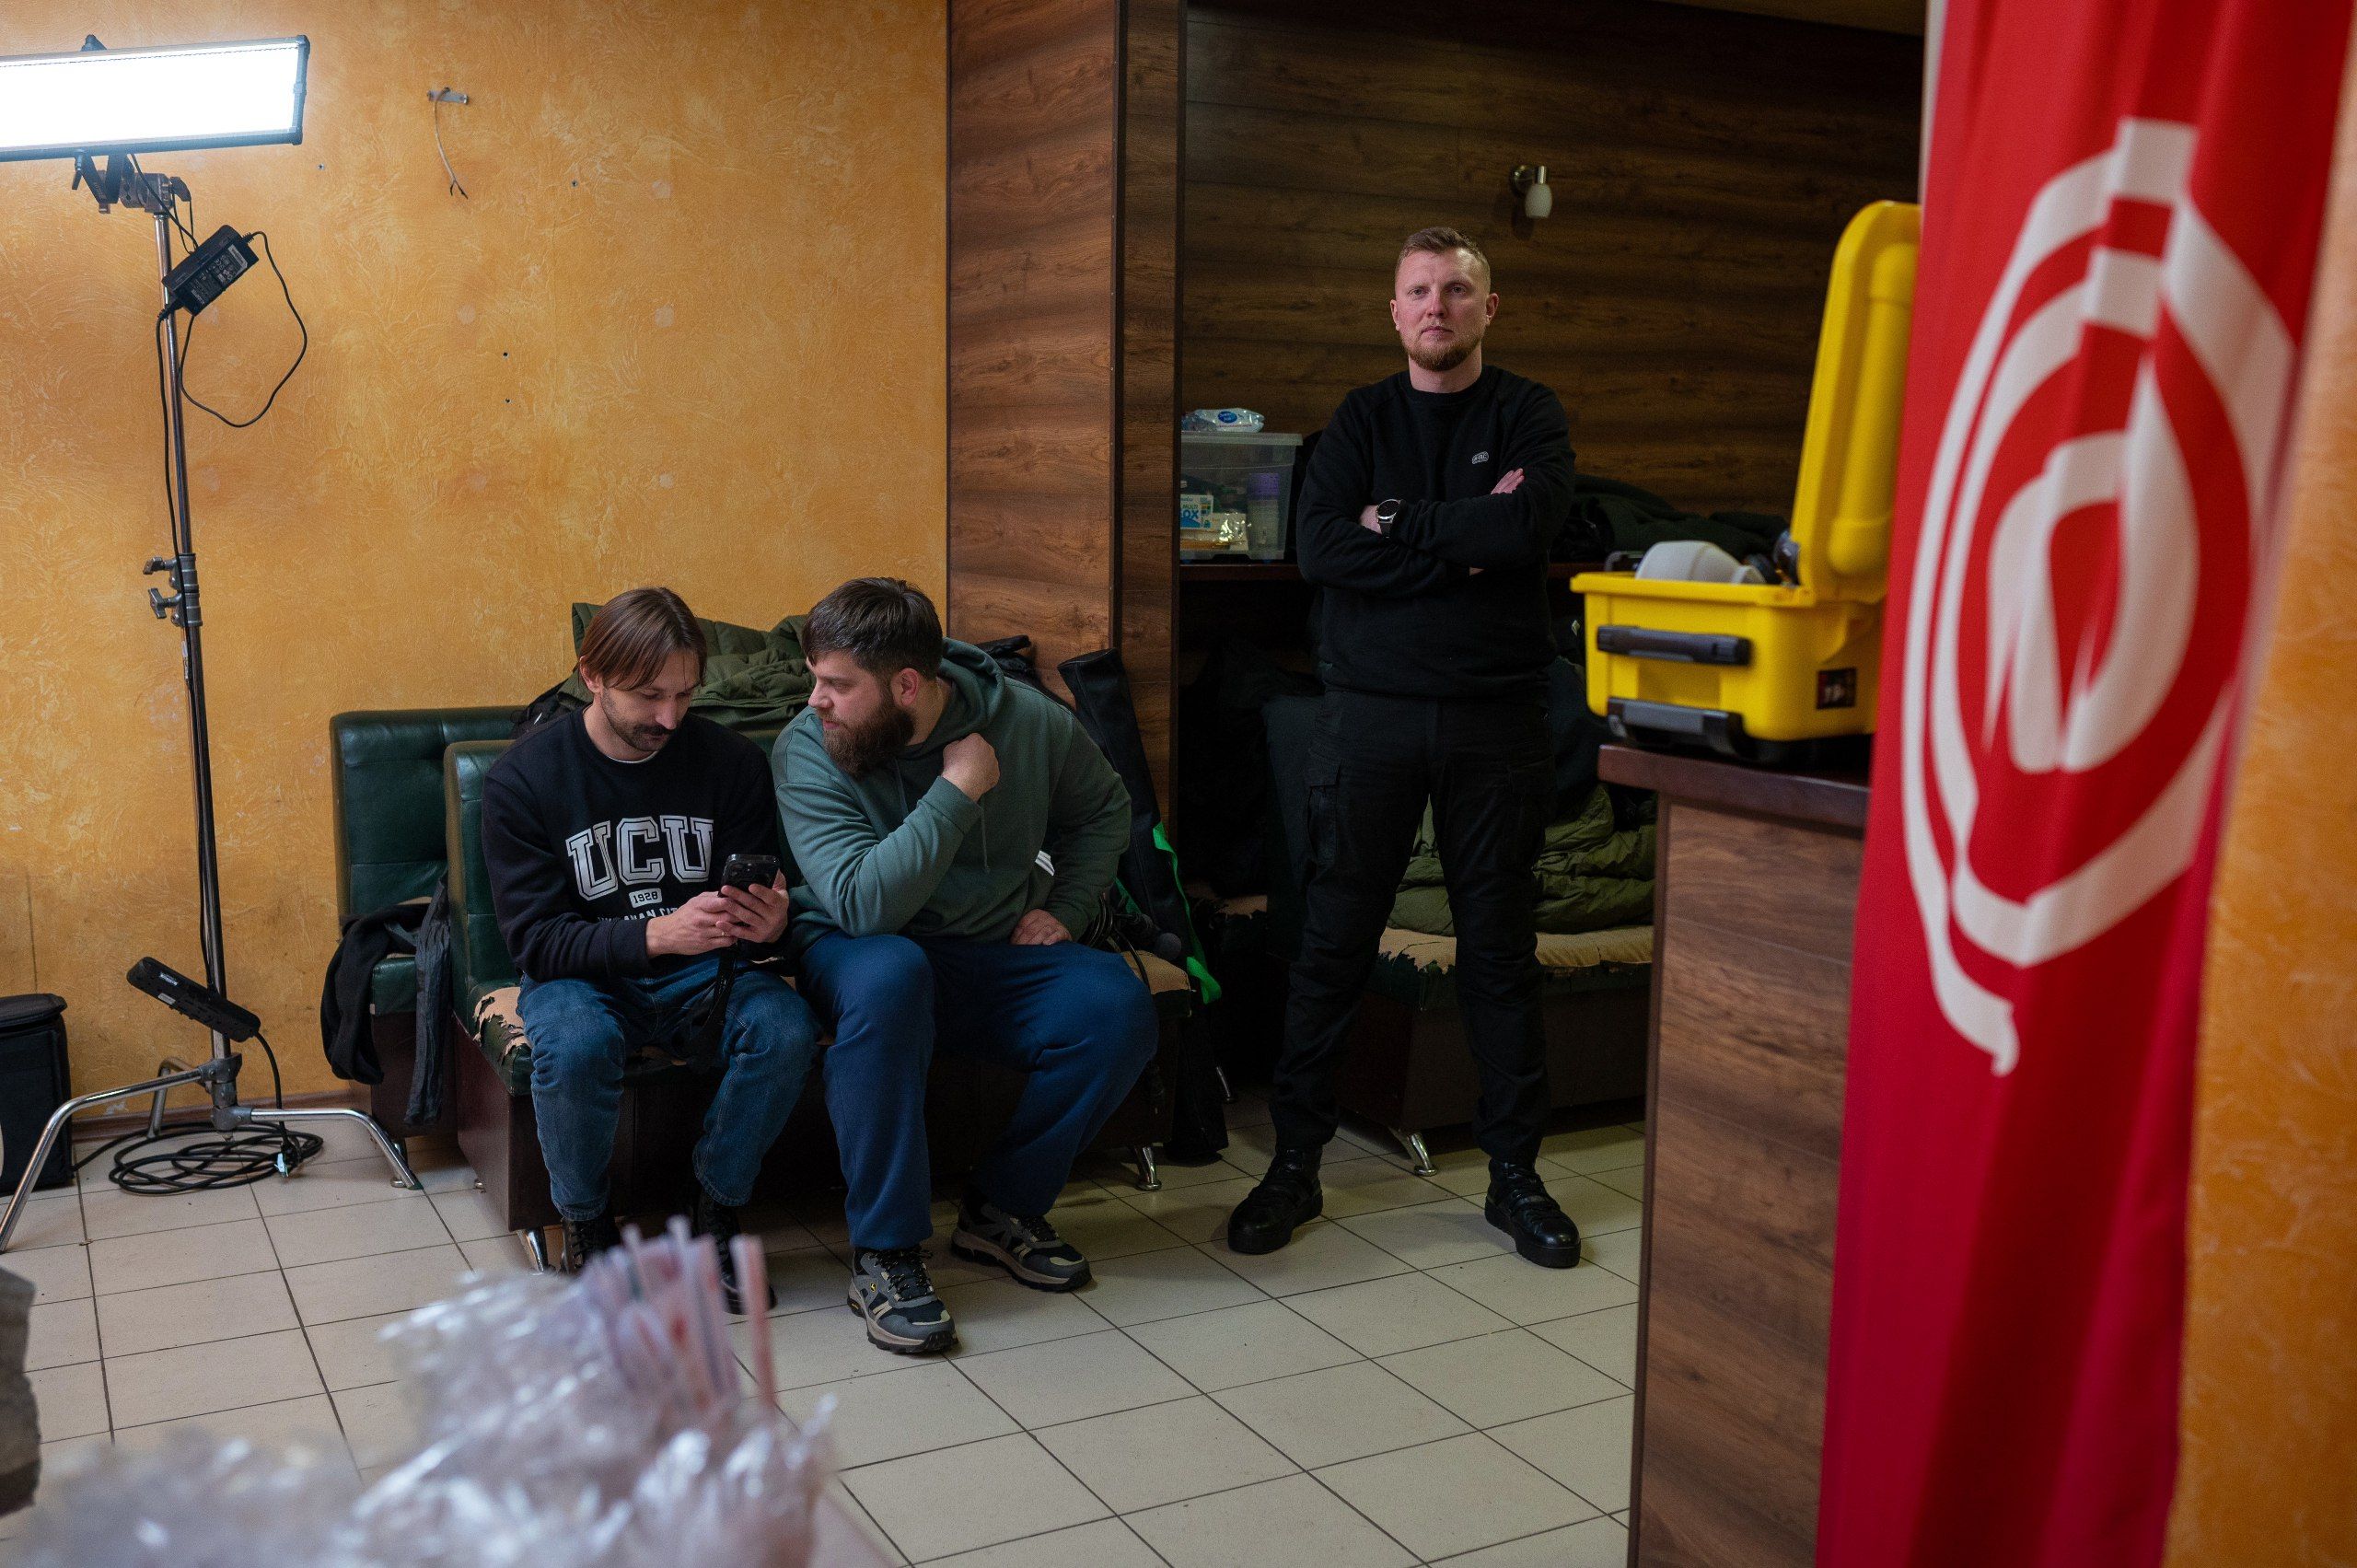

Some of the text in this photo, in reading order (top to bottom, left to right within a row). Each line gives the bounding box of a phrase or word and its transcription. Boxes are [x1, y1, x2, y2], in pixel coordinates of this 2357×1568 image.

[1180, 509, 1199, 519] OX
[565, 815, 714, 901] UCU
[633, 890, 658, 903] 1928
